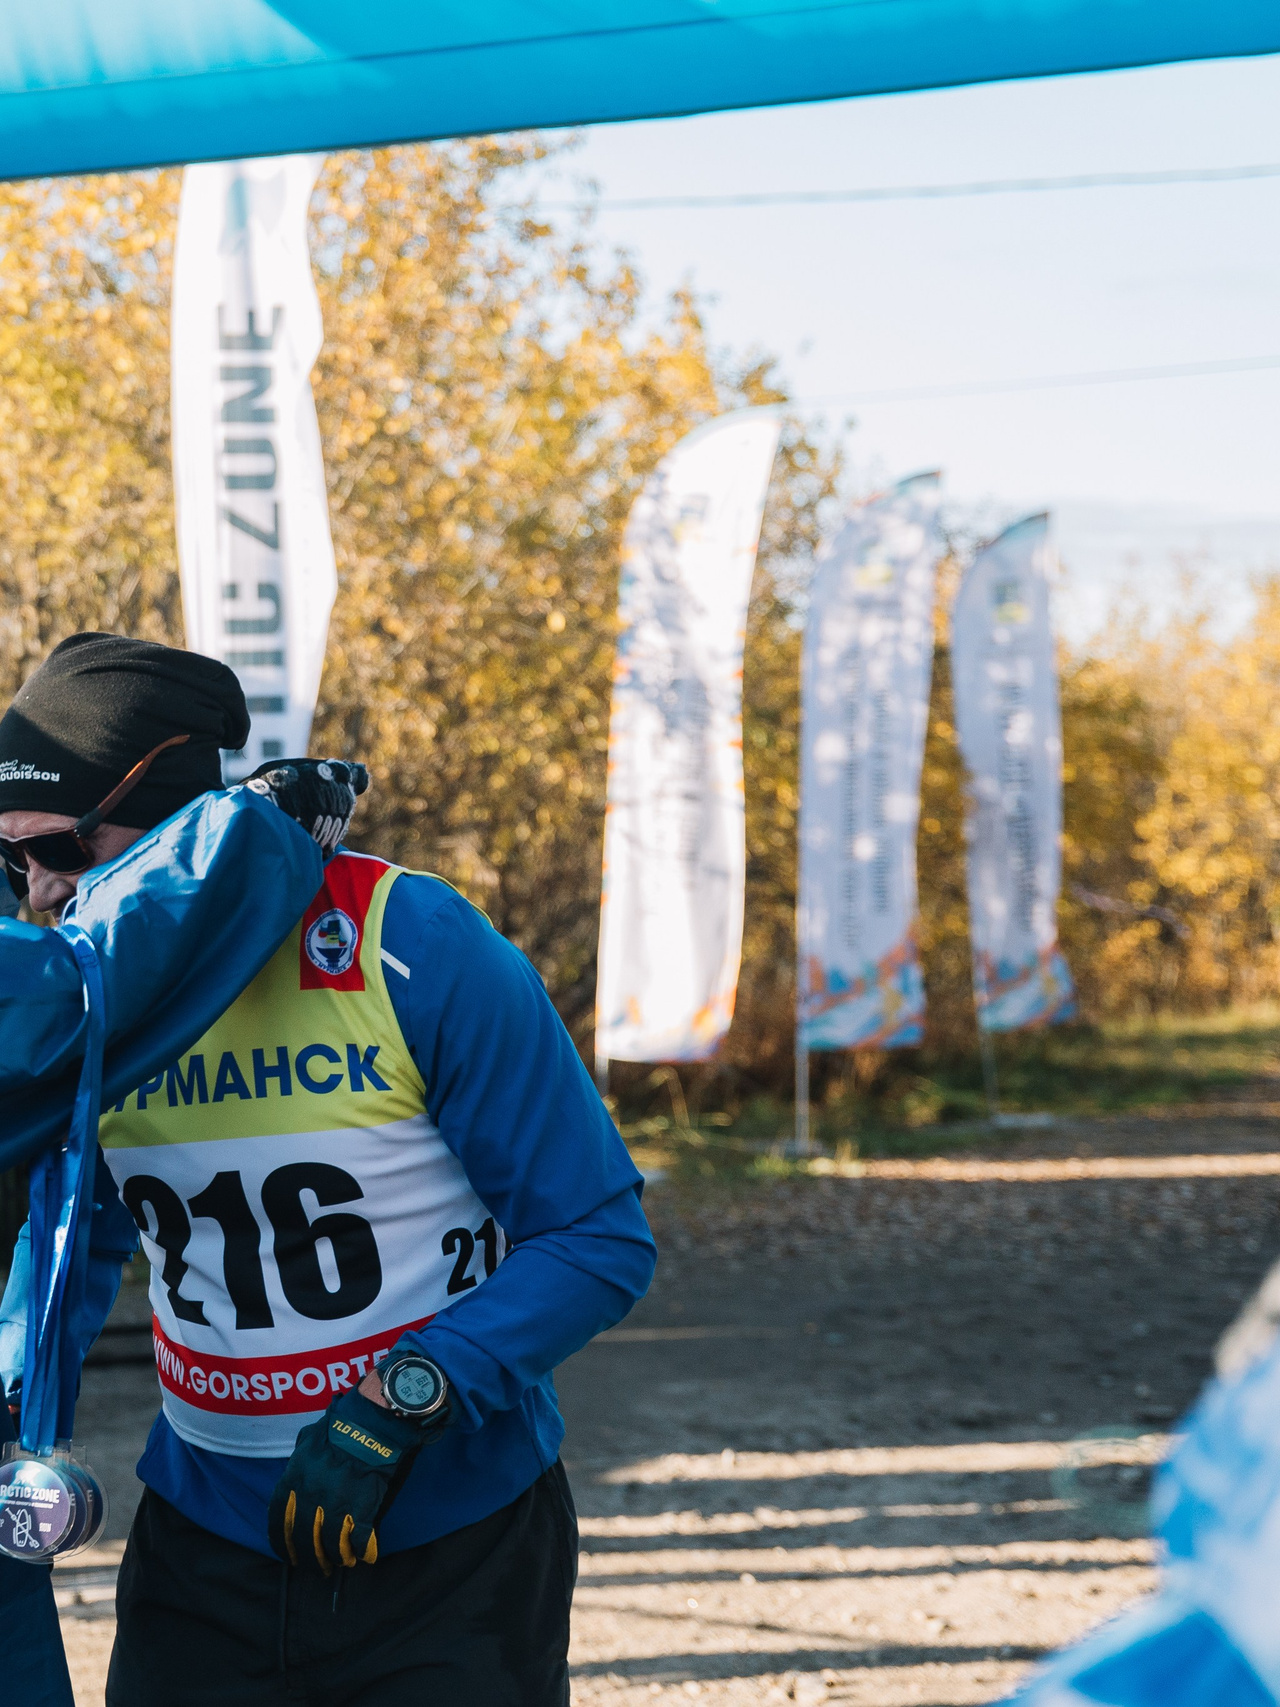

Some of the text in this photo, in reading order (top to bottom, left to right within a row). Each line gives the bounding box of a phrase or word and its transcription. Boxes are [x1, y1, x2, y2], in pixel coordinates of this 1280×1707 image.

[218, 304, 283, 550] ZONE
[102, 1043, 393, 1114] РМАНСК
[122, 1162, 383, 1330] 216
[441, 1217, 513, 1296] 21
[331, 1419, 393, 1458] TLD RACING
[31, 1487, 61, 1503] ZONE
